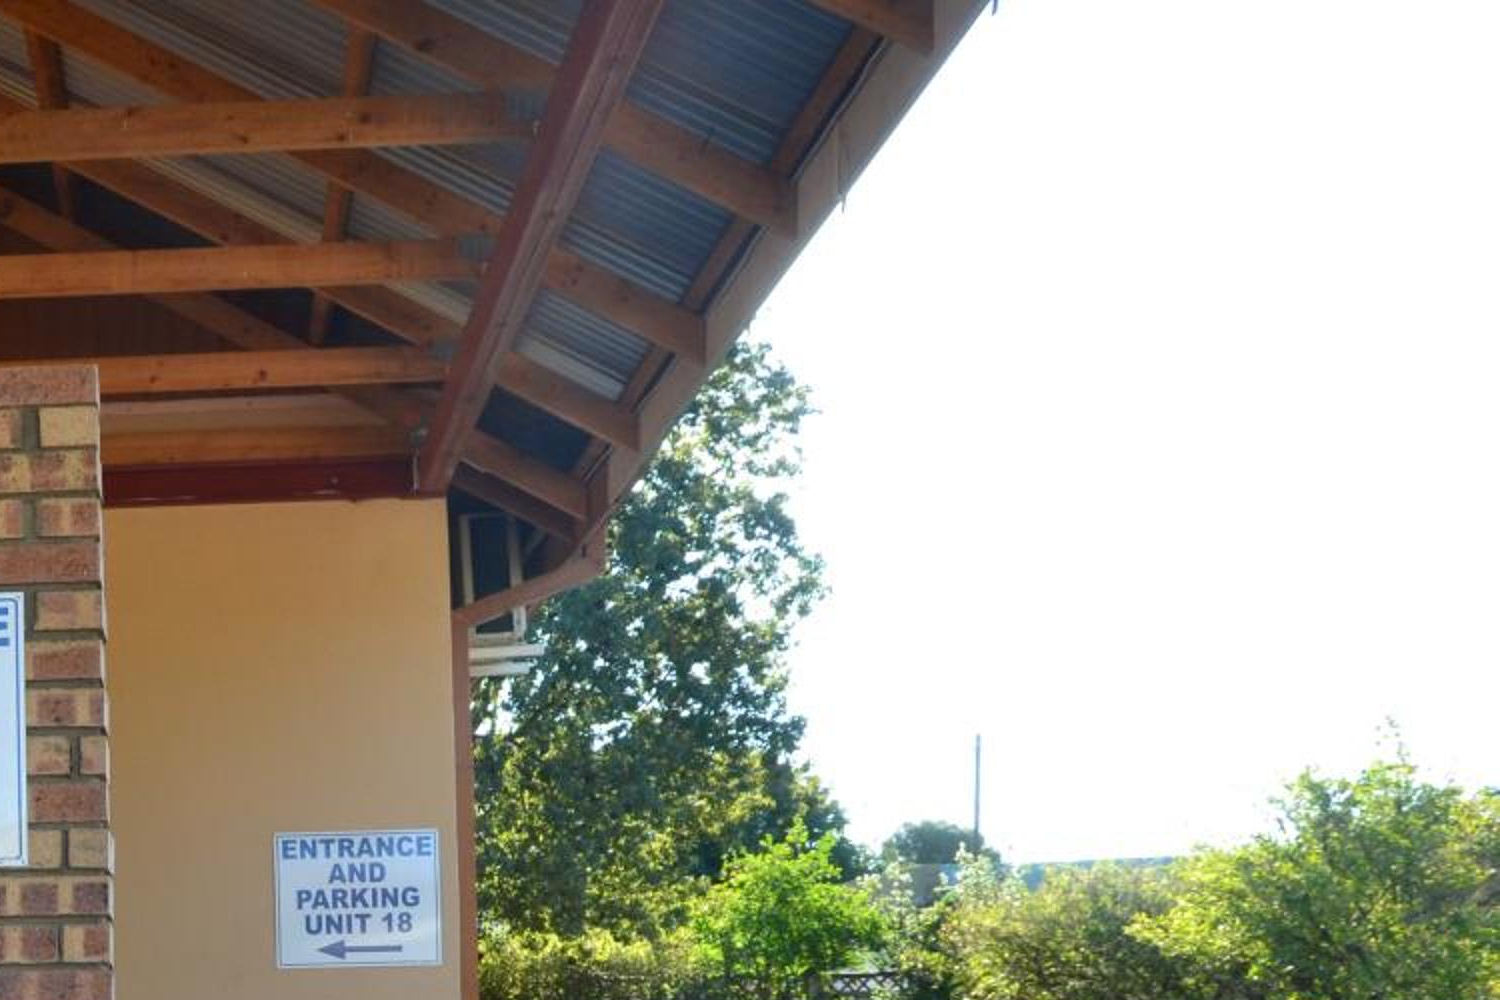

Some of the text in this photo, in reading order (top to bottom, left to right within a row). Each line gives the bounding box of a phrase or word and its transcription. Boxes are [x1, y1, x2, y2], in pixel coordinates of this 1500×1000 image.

[282, 836, 431, 859] ENTRANCE
[329, 862, 386, 884] AND
[297, 887, 420, 910] PARKING
[304, 912, 412, 935] UNIT 18
